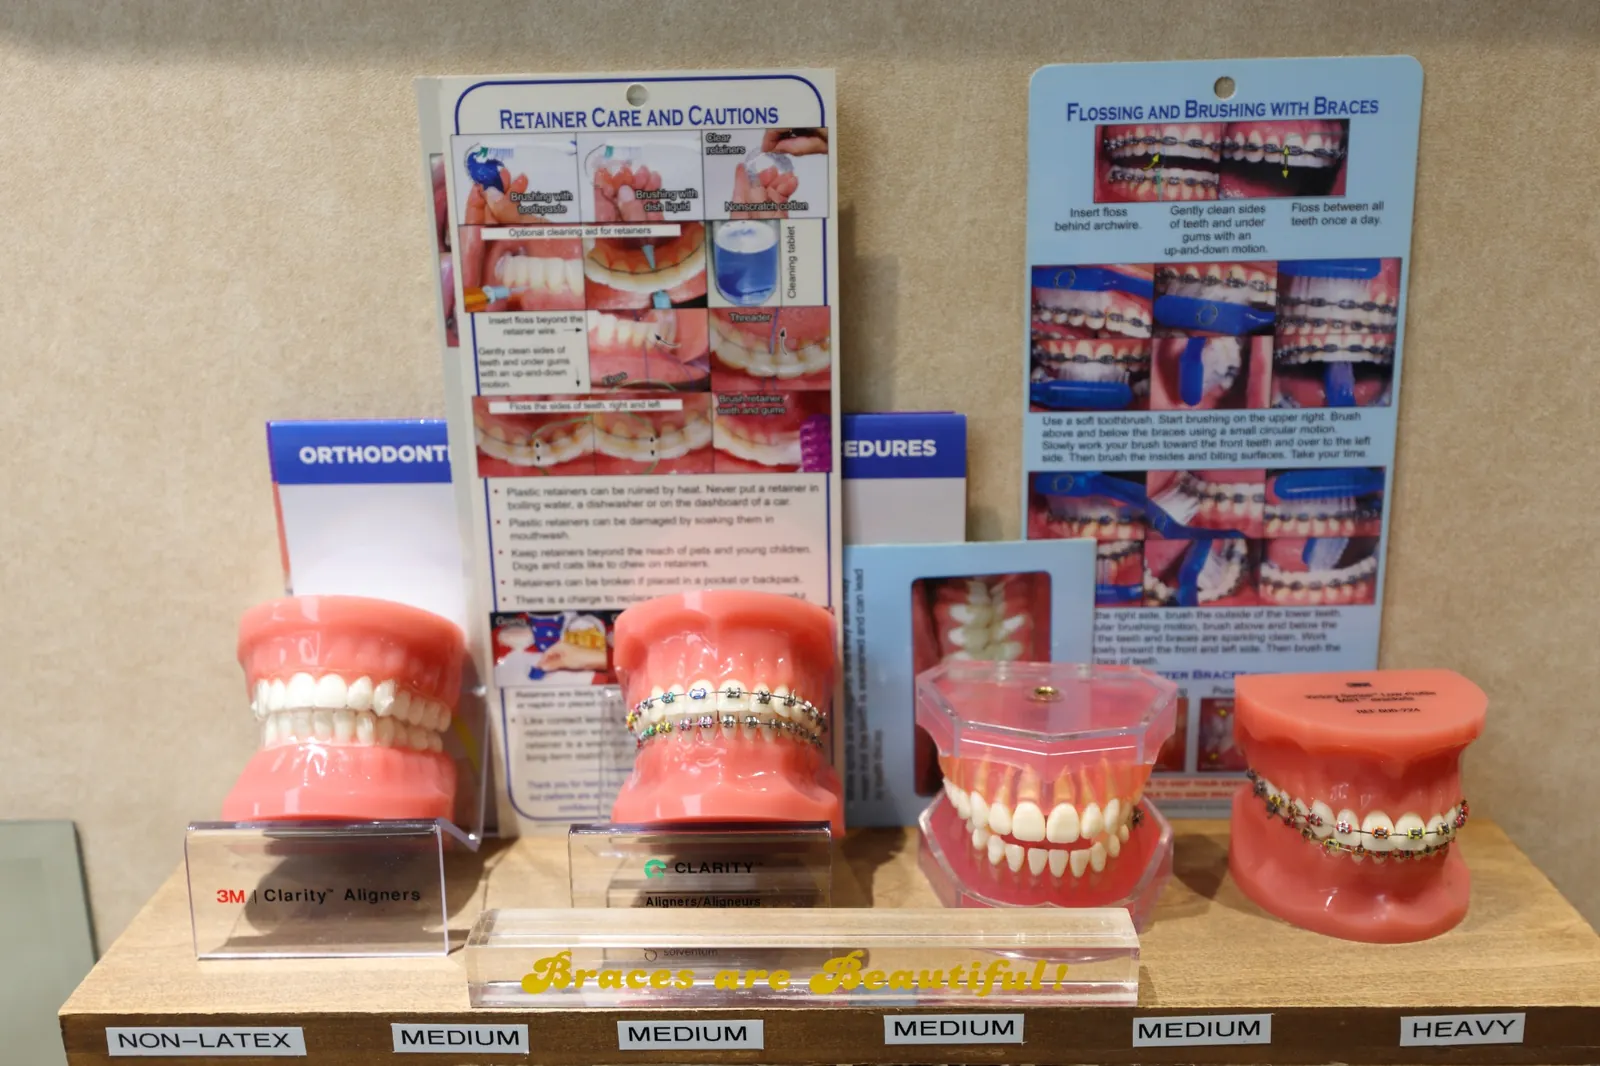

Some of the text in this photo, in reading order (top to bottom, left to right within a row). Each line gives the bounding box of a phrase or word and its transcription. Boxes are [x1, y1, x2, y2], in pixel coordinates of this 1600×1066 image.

[706, 133, 731, 143] Clear
[706, 145, 746, 154] retainers
[511, 191, 573, 203] Brushing with
[635, 189, 698, 201] Brushing with
[518, 204, 567, 215] toothpaste
[644, 202, 690, 213] dish liquid
[725, 201, 808, 212] Nonscratch cotton
[1070, 207, 1128, 218] Insert floss
[1170, 203, 1266, 218] Gently clean sides
[1291, 201, 1384, 212] Floss between all
[1054, 220, 1142, 231] behind archwire.
[1169, 217, 1265, 229] of teeth and under
[1291, 214, 1382, 227] teeth once a day.
[508, 226, 652, 239] Optional cleaning aid for retainers
[1182, 231, 1252, 244] gums with an
[1231, 243, 1268, 254] motion.
[787, 226, 798, 298] Cleaning tablet
[488, 314, 583, 326] Insert floss beyond the
[729, 312, 772, 323] Threader
[1042, 416, 1063, 425] Use
[1074, 416, 1094, 425] soft
[1159, 414, 1184, 423] Start
[1186, 414, 1230, 425] brushing
[1248, 413, 1265, 422] the
[1267, 415, 1297, 424] upper
[1299, 412, 1325, 424] right.
[1330, 412, 1361, 421] Brush
[1042, 428, 1074, 438] above
[1076, 428, 1096, 437] and
[1098, 427, 1130, 437] below
[1132, 427, 1149, 436] the
[1151, 427, 1186, 436] braces
[1188, 426, 1217, 438] using
[1229, 426, 1257, 435] small
[1259, 425, 1297, 434] circular
[1299, 424, 1338, 434] motion.
[841, 440, 937, 458] EDURES
[1042, 440, 1076, 452] Slowly
[1078, 440, 1104, 449] work
[1106, 441, 1129, 451] your
[1131, 439, 1161, 448] brush
[1163, 438, 1198, 448] toward
[1200, 438, 1218, 447] the
[1220, 438, 1244, 447] front
[1246, 438, 1272, 447] teeth
[1274, 437, 1295, 446] and
[1322, 437, 1333, 446] to
[1335, 437, 1352, 446] the
[1354, 436, 1371, 446] left
[1042, 449, 1369, 462] side. Then brush the insides and biting surfaces. Take your time.
[216, 890, 244, 904] 3M
[344, 888, 420, 904] Aligners
[521, 950, 1069, 997] Braces are Beautiful!
[629, 1026, 746, 1041] MEDIUM
[895, 1020, 1013, 1036] MEDIUM
[1139, 1021, 1260, 1038] MEDIUM
[1414, 1020, 1515, 1037] HEAVY
[119, 1033, 290, 1048] NON-LATEX
[402, 1030, 519, 1045] MEDIUM
